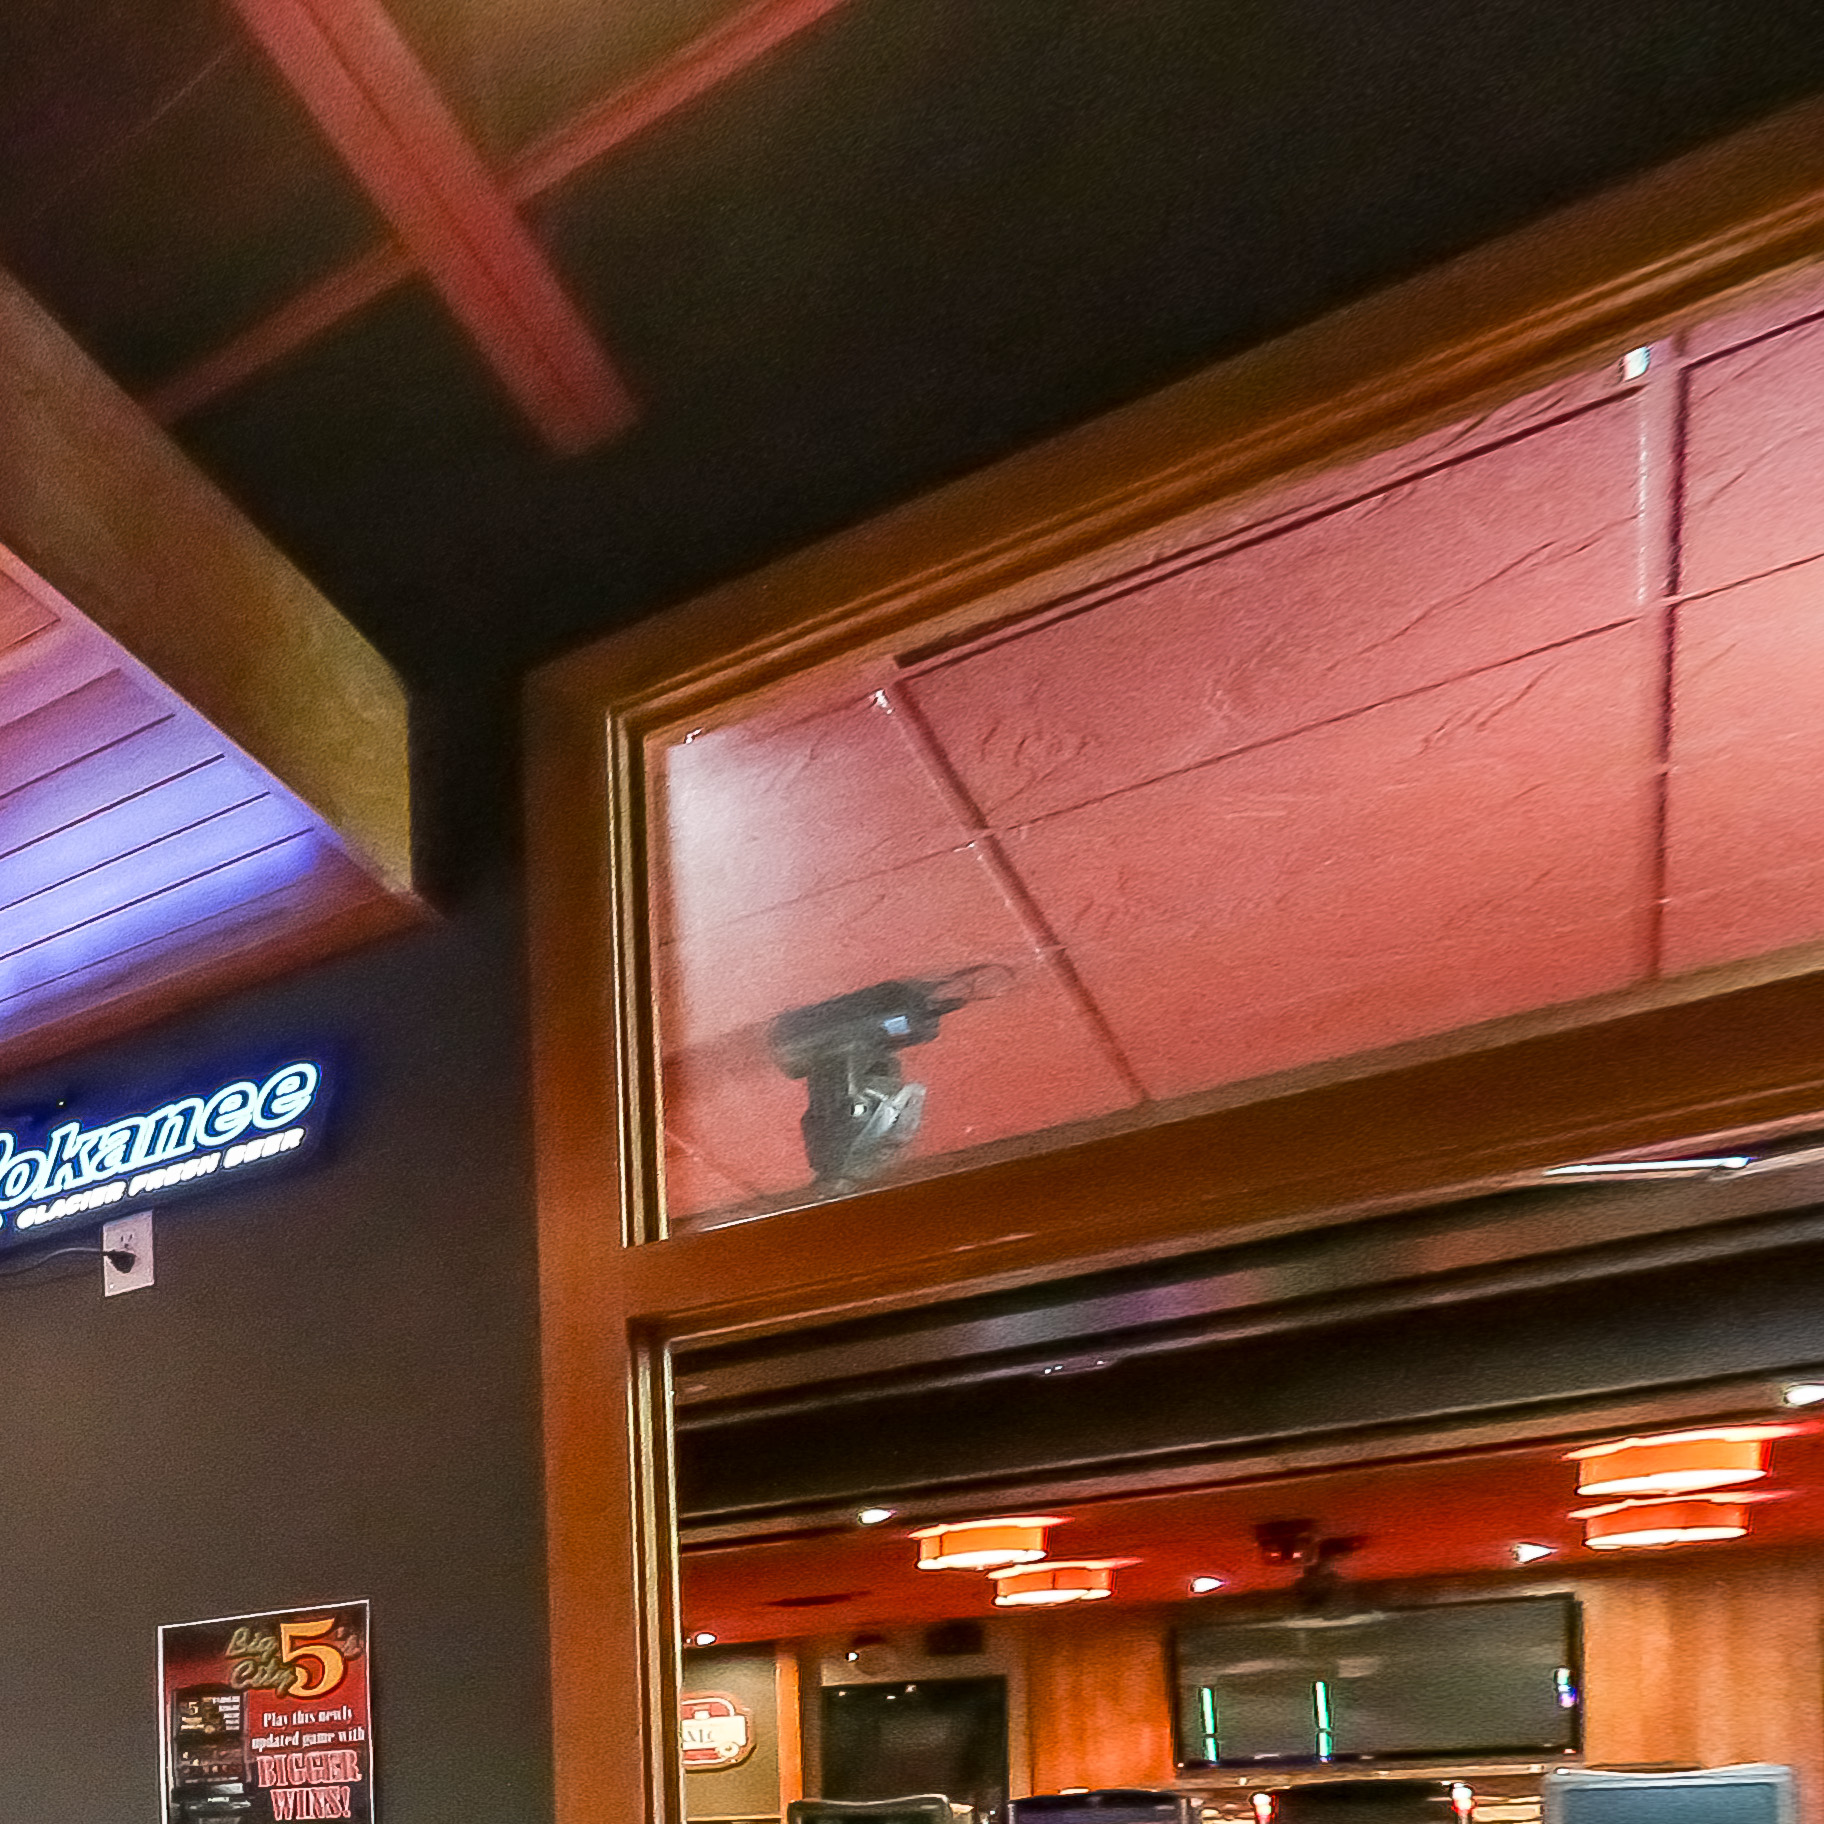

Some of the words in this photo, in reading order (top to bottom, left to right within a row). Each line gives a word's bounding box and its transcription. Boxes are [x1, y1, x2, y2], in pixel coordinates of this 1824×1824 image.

[16, 1181, 126, 1230] GLACIER
[128, 1152, 222, 1196] FRESH
[263, 1711, 288, 1730] Play
[292, 1709, 316, 1726] this
[252, 1730, 300, 1752] updated
[338, 1726, 365, 1742] with
[256, 1749, 363, 1788] BIGGER
[270, 1785, 351, 1821] WINS!
